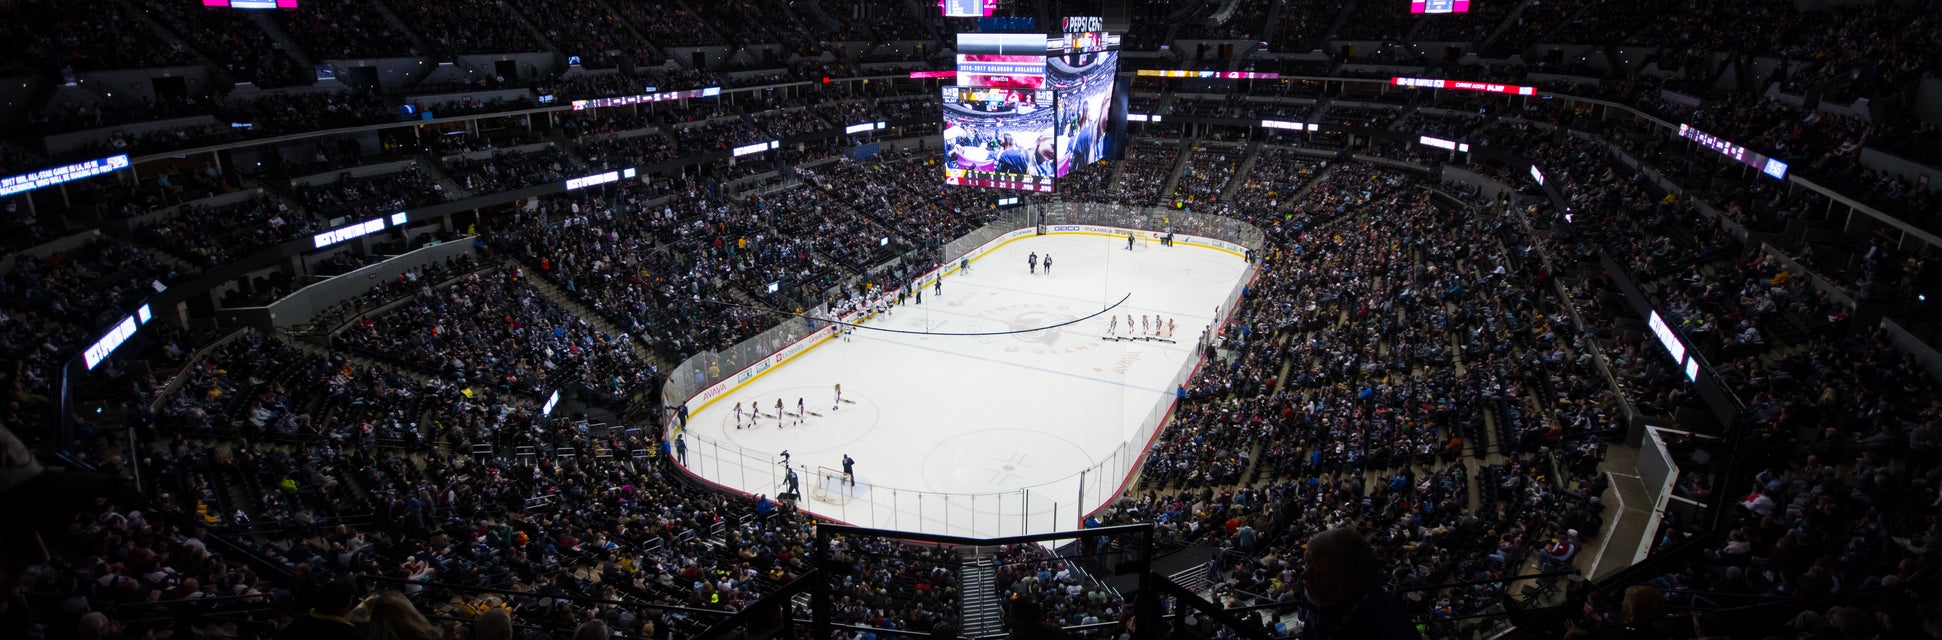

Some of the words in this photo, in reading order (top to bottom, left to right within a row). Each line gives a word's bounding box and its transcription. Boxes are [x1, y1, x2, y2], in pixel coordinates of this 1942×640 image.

[1070, 16, 1088, 32] PEPSI
[28, 170, 53, 182] ALL-STAR
[53, 166, 69, 176] GAME
[703, 383, 726, 400] AVAYA
